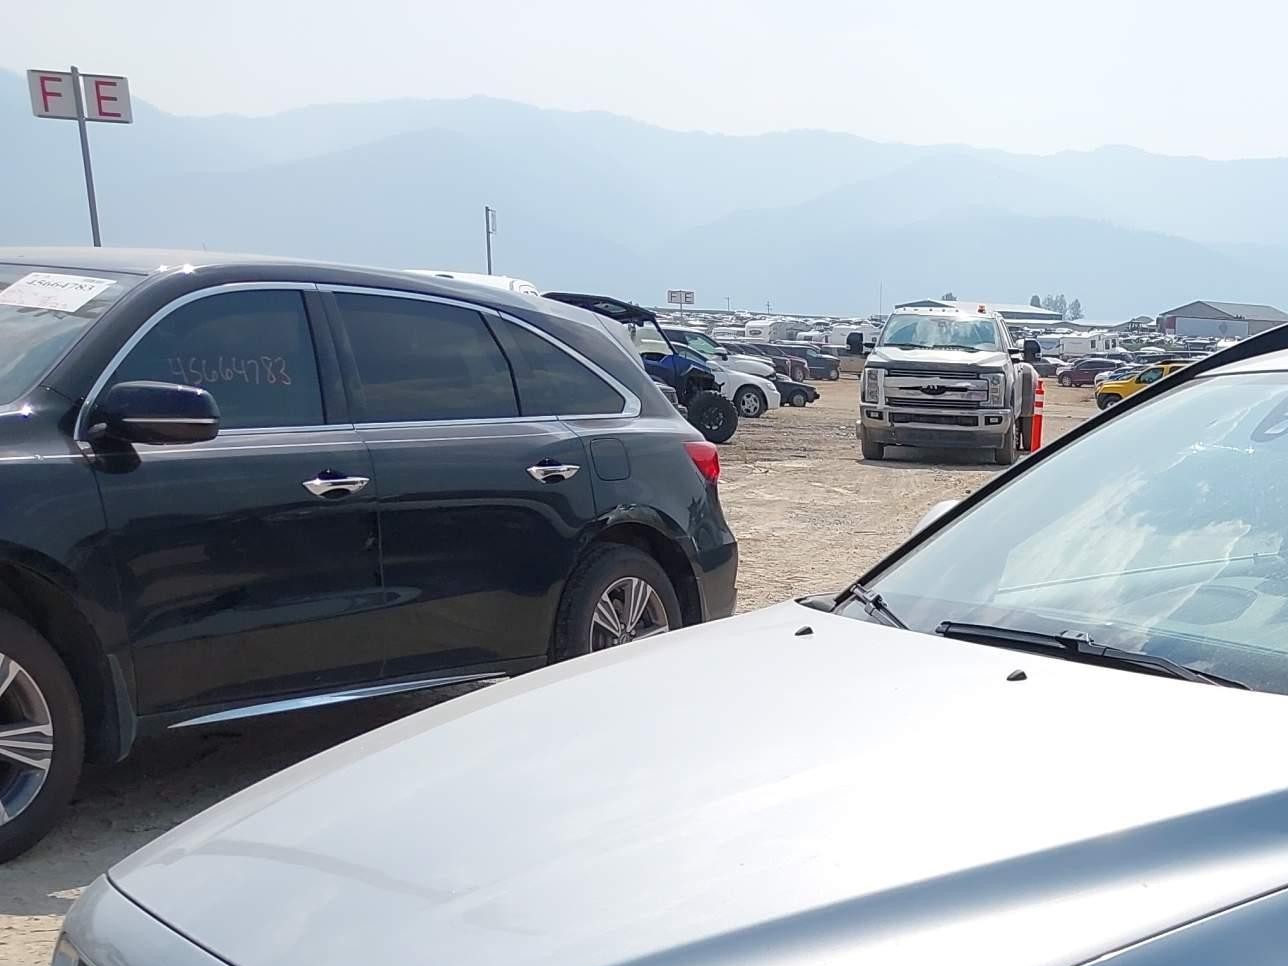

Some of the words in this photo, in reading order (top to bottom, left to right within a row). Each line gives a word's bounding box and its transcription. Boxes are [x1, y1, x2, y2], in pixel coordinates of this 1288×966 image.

[40, 76, 62, 113] F
[95, 80, 122, 117] E
[168, 356, 291, 385] 45664783
